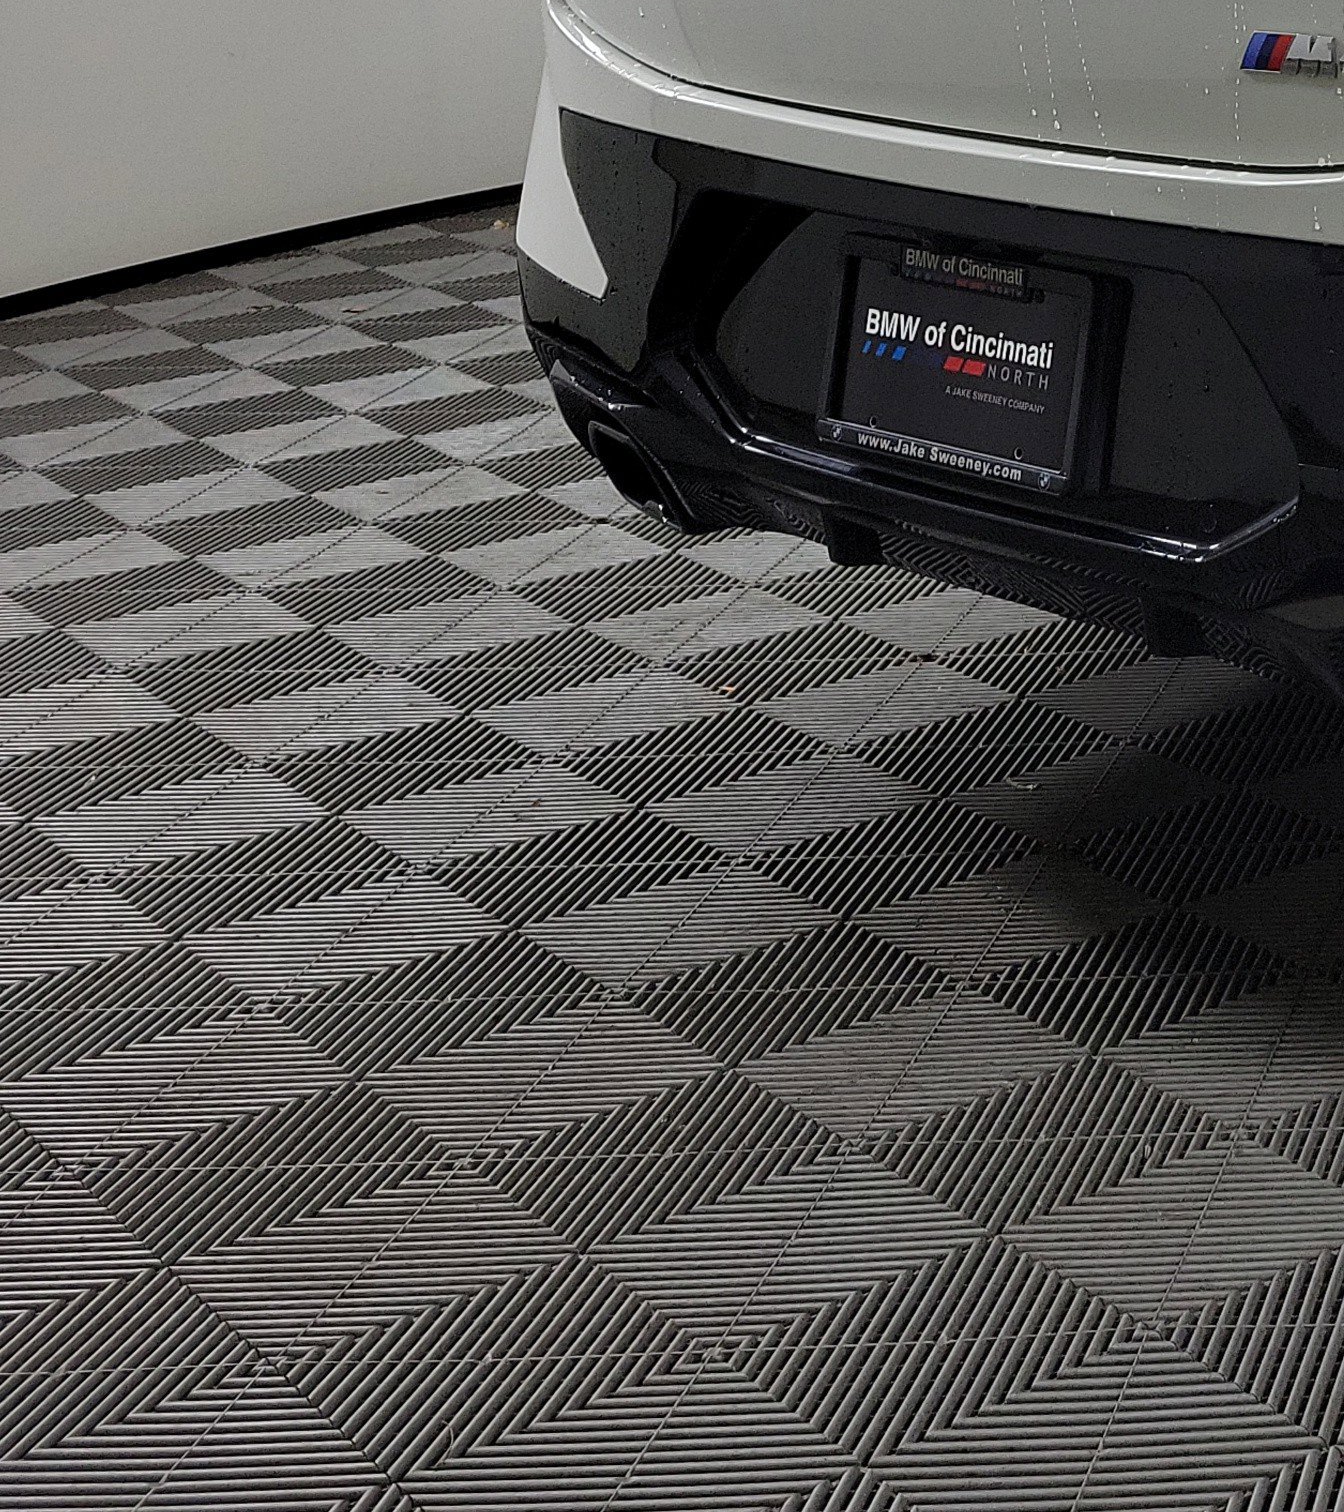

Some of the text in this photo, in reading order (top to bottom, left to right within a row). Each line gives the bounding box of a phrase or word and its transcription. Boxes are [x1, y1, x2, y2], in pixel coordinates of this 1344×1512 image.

[905, 248, 1024, 286] BMW of Cincinnati
[865, 308, 1054, 370] BMW of Cincinnati
[988, 363, 1050, 390] NORTH
[952, 388, 972, 400] JAKE
[1008, 398, 1046, 415] COMPANY
[857, 432, 1022, 482] www.Jake Sweeney.com
